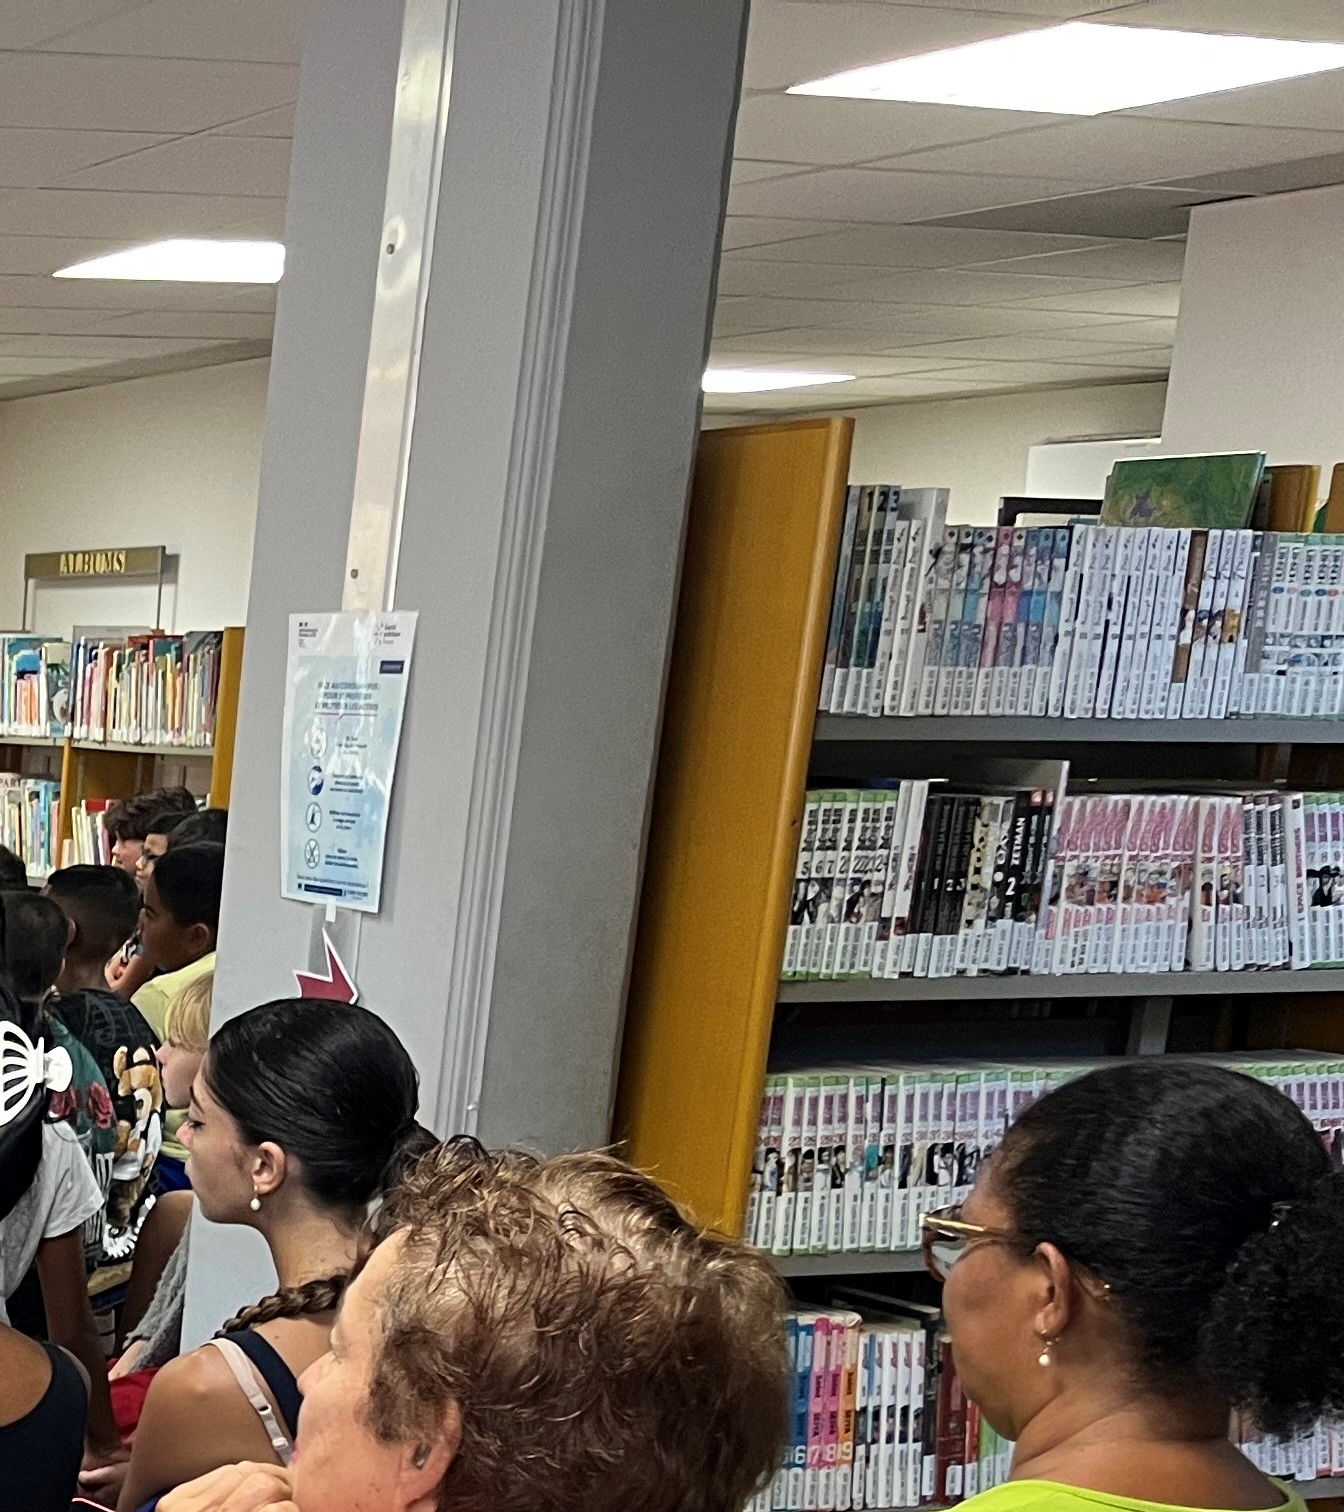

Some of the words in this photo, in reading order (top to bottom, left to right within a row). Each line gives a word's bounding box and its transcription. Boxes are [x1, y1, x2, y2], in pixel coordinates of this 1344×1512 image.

[59, 551, 126, 576] ALBUMS
[1011, 817, 1025, 866] ZETMAN
[1005, 876, 1016, 896] 2
[795, 1445, 807, 1464] 6
[825, 1443, 837, 1462] 8
